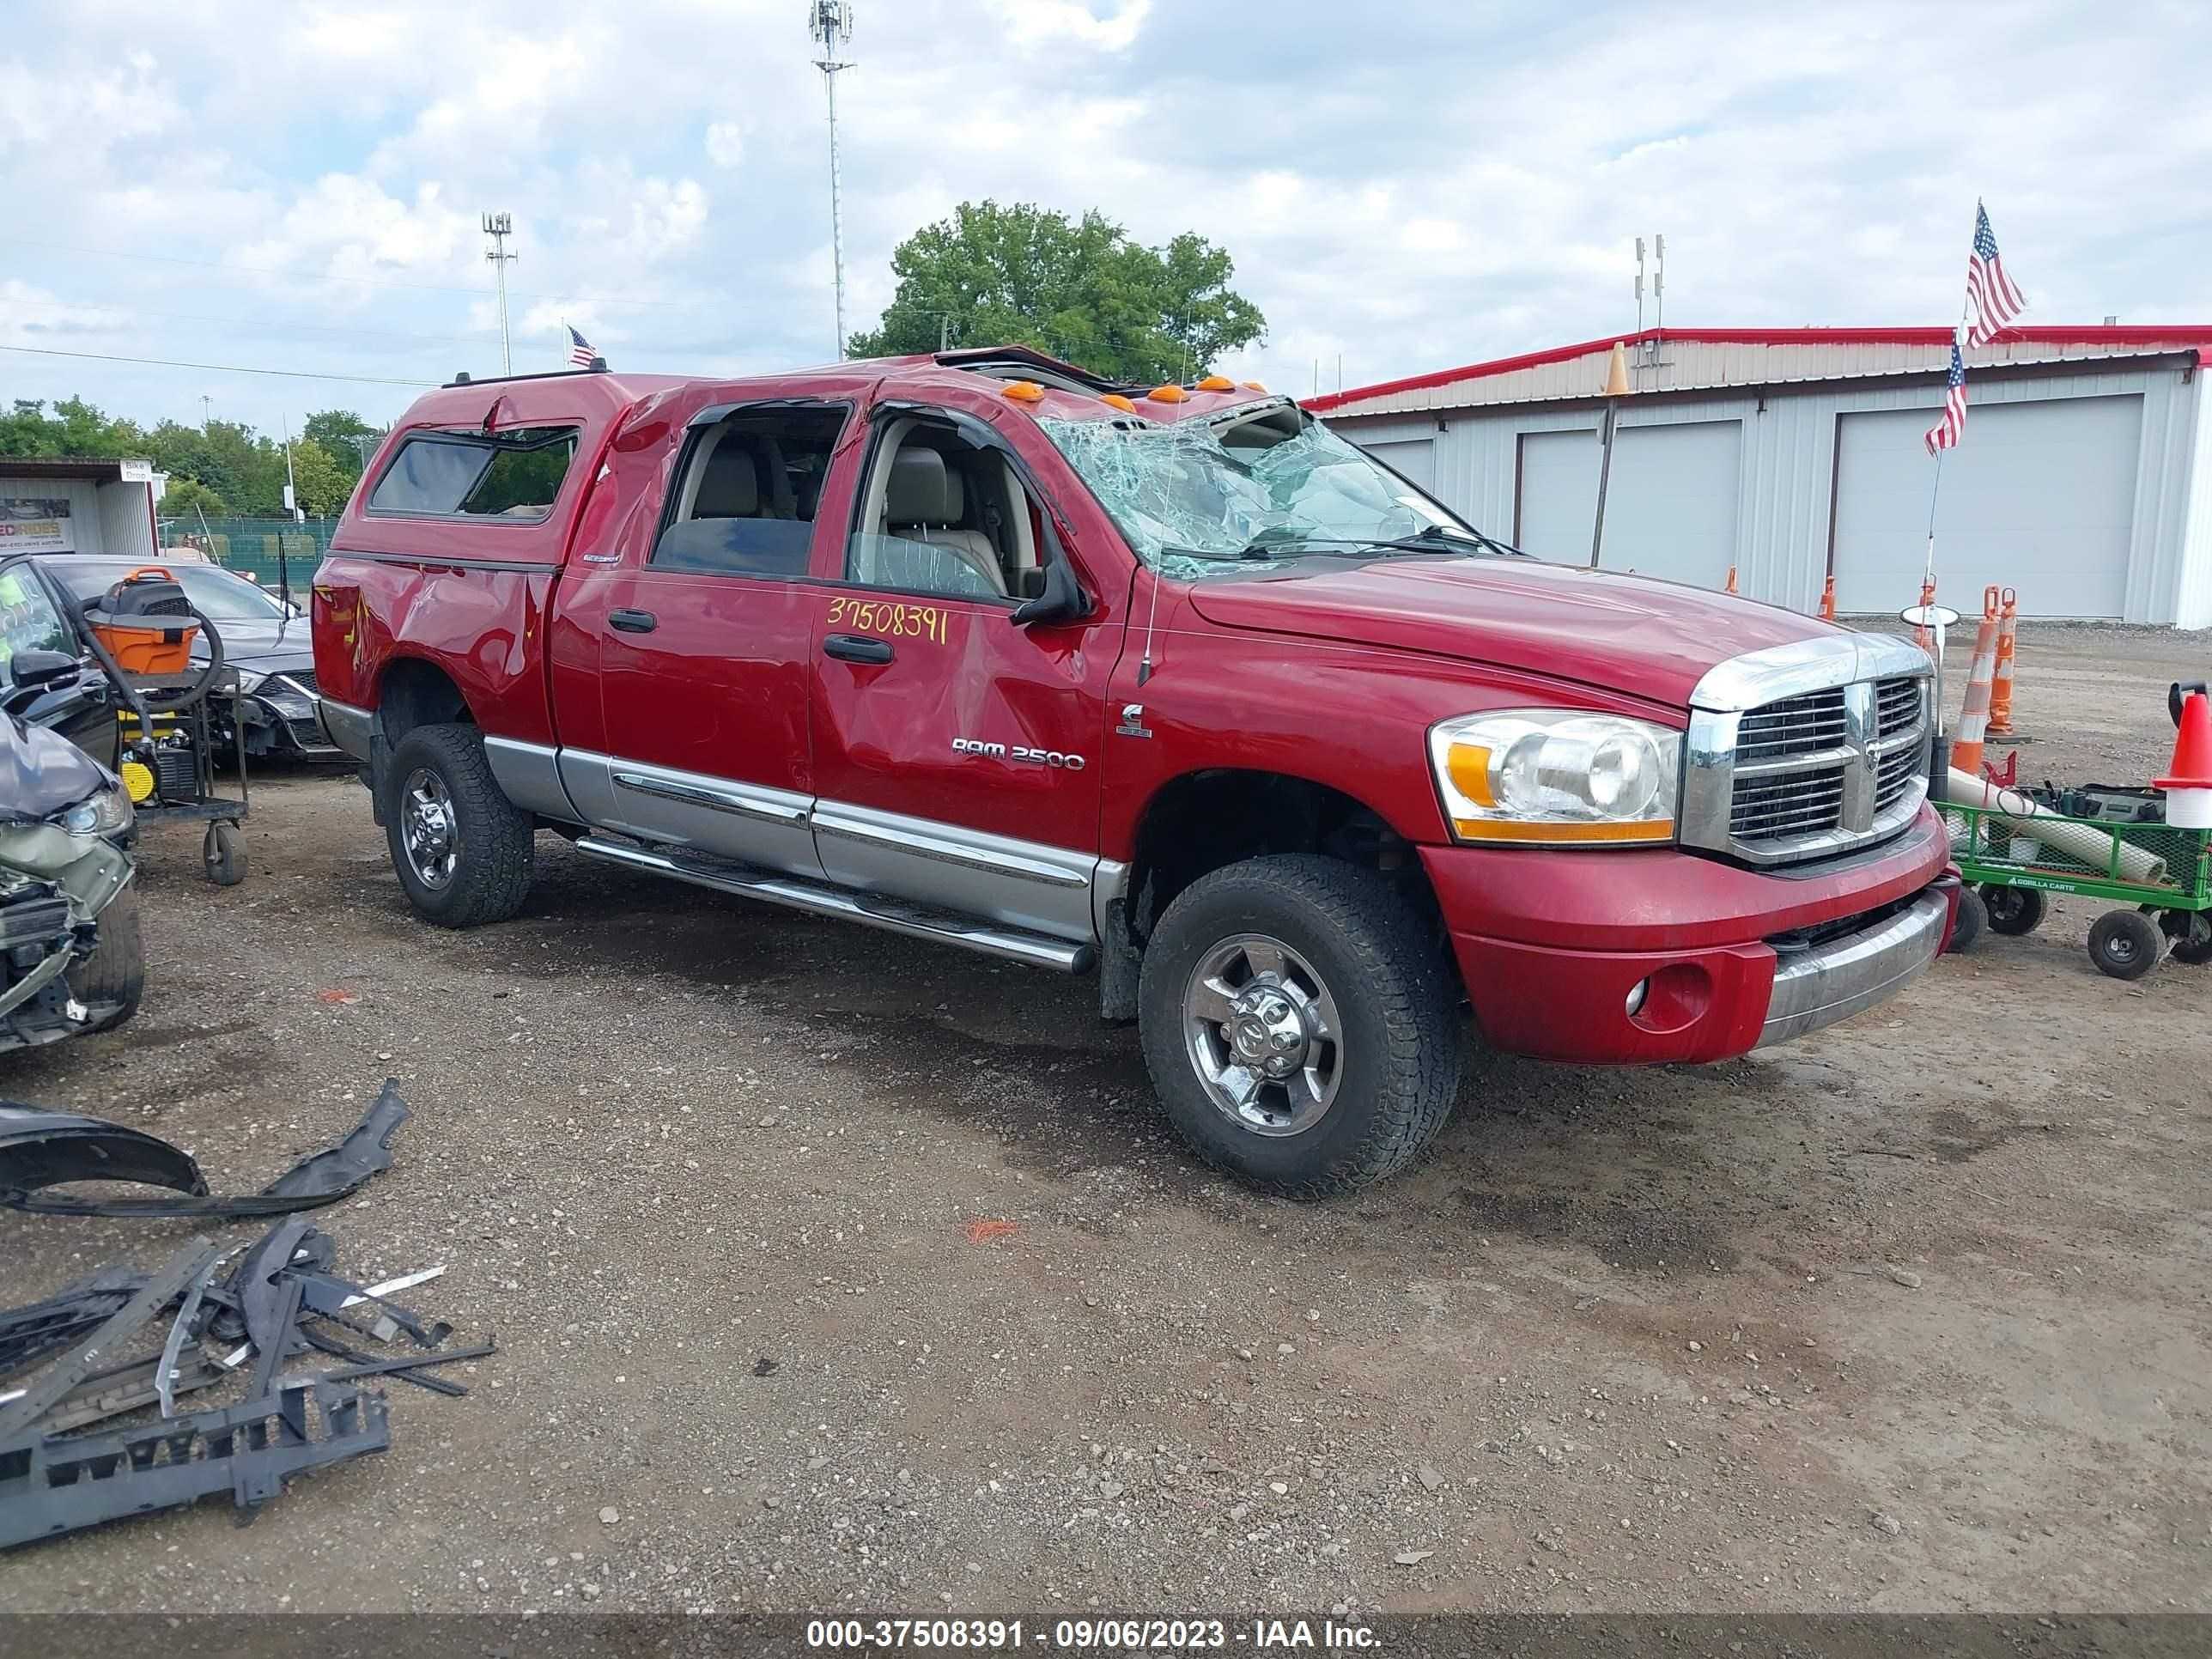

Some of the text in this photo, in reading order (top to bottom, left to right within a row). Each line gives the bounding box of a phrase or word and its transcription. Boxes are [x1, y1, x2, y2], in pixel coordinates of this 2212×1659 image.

[125, 471, 146, 480] Drop
[827, 597, 948, 646] 37508391
[952, 738, 1085, 771] RAM 2500
